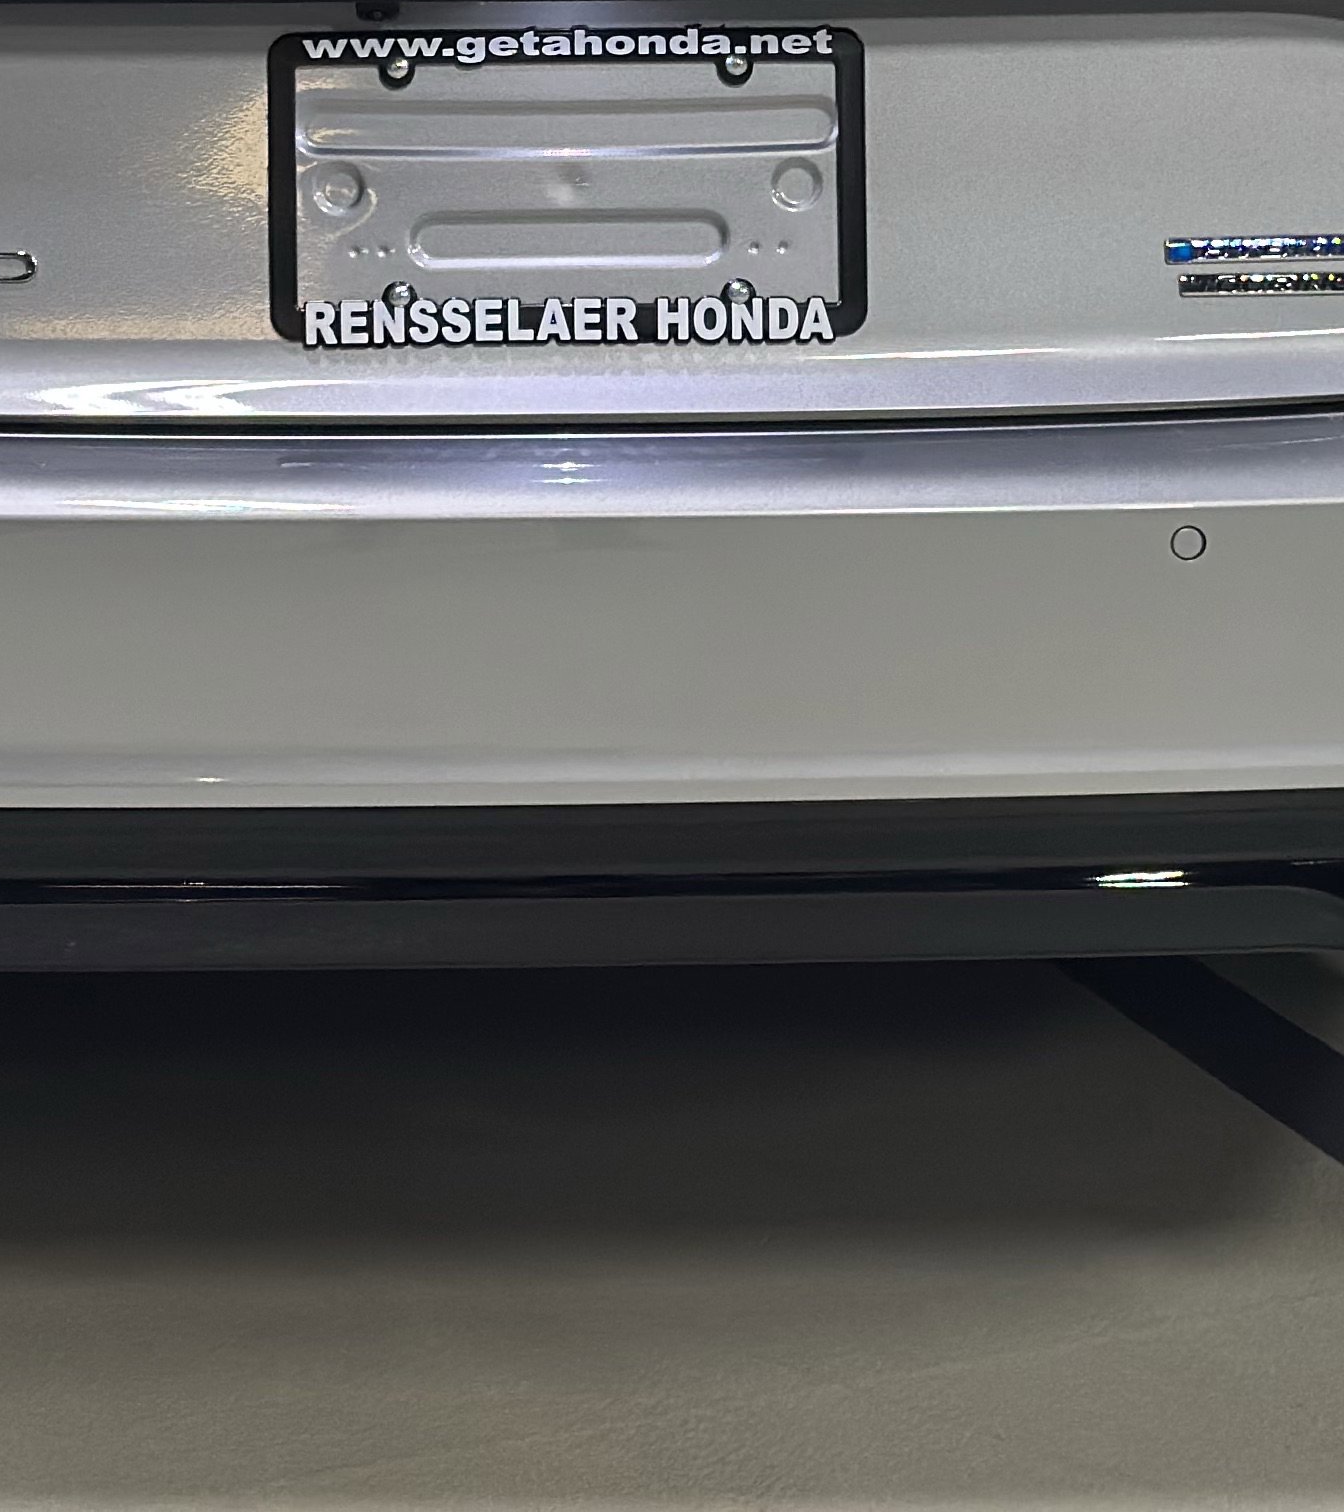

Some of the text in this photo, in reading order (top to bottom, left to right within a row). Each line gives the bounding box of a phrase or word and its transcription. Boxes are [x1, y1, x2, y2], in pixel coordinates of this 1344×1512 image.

[302, 28, 833, 64] www.getahonda.net
[305, 295, 834, 345] RENSSELAER HONDA
